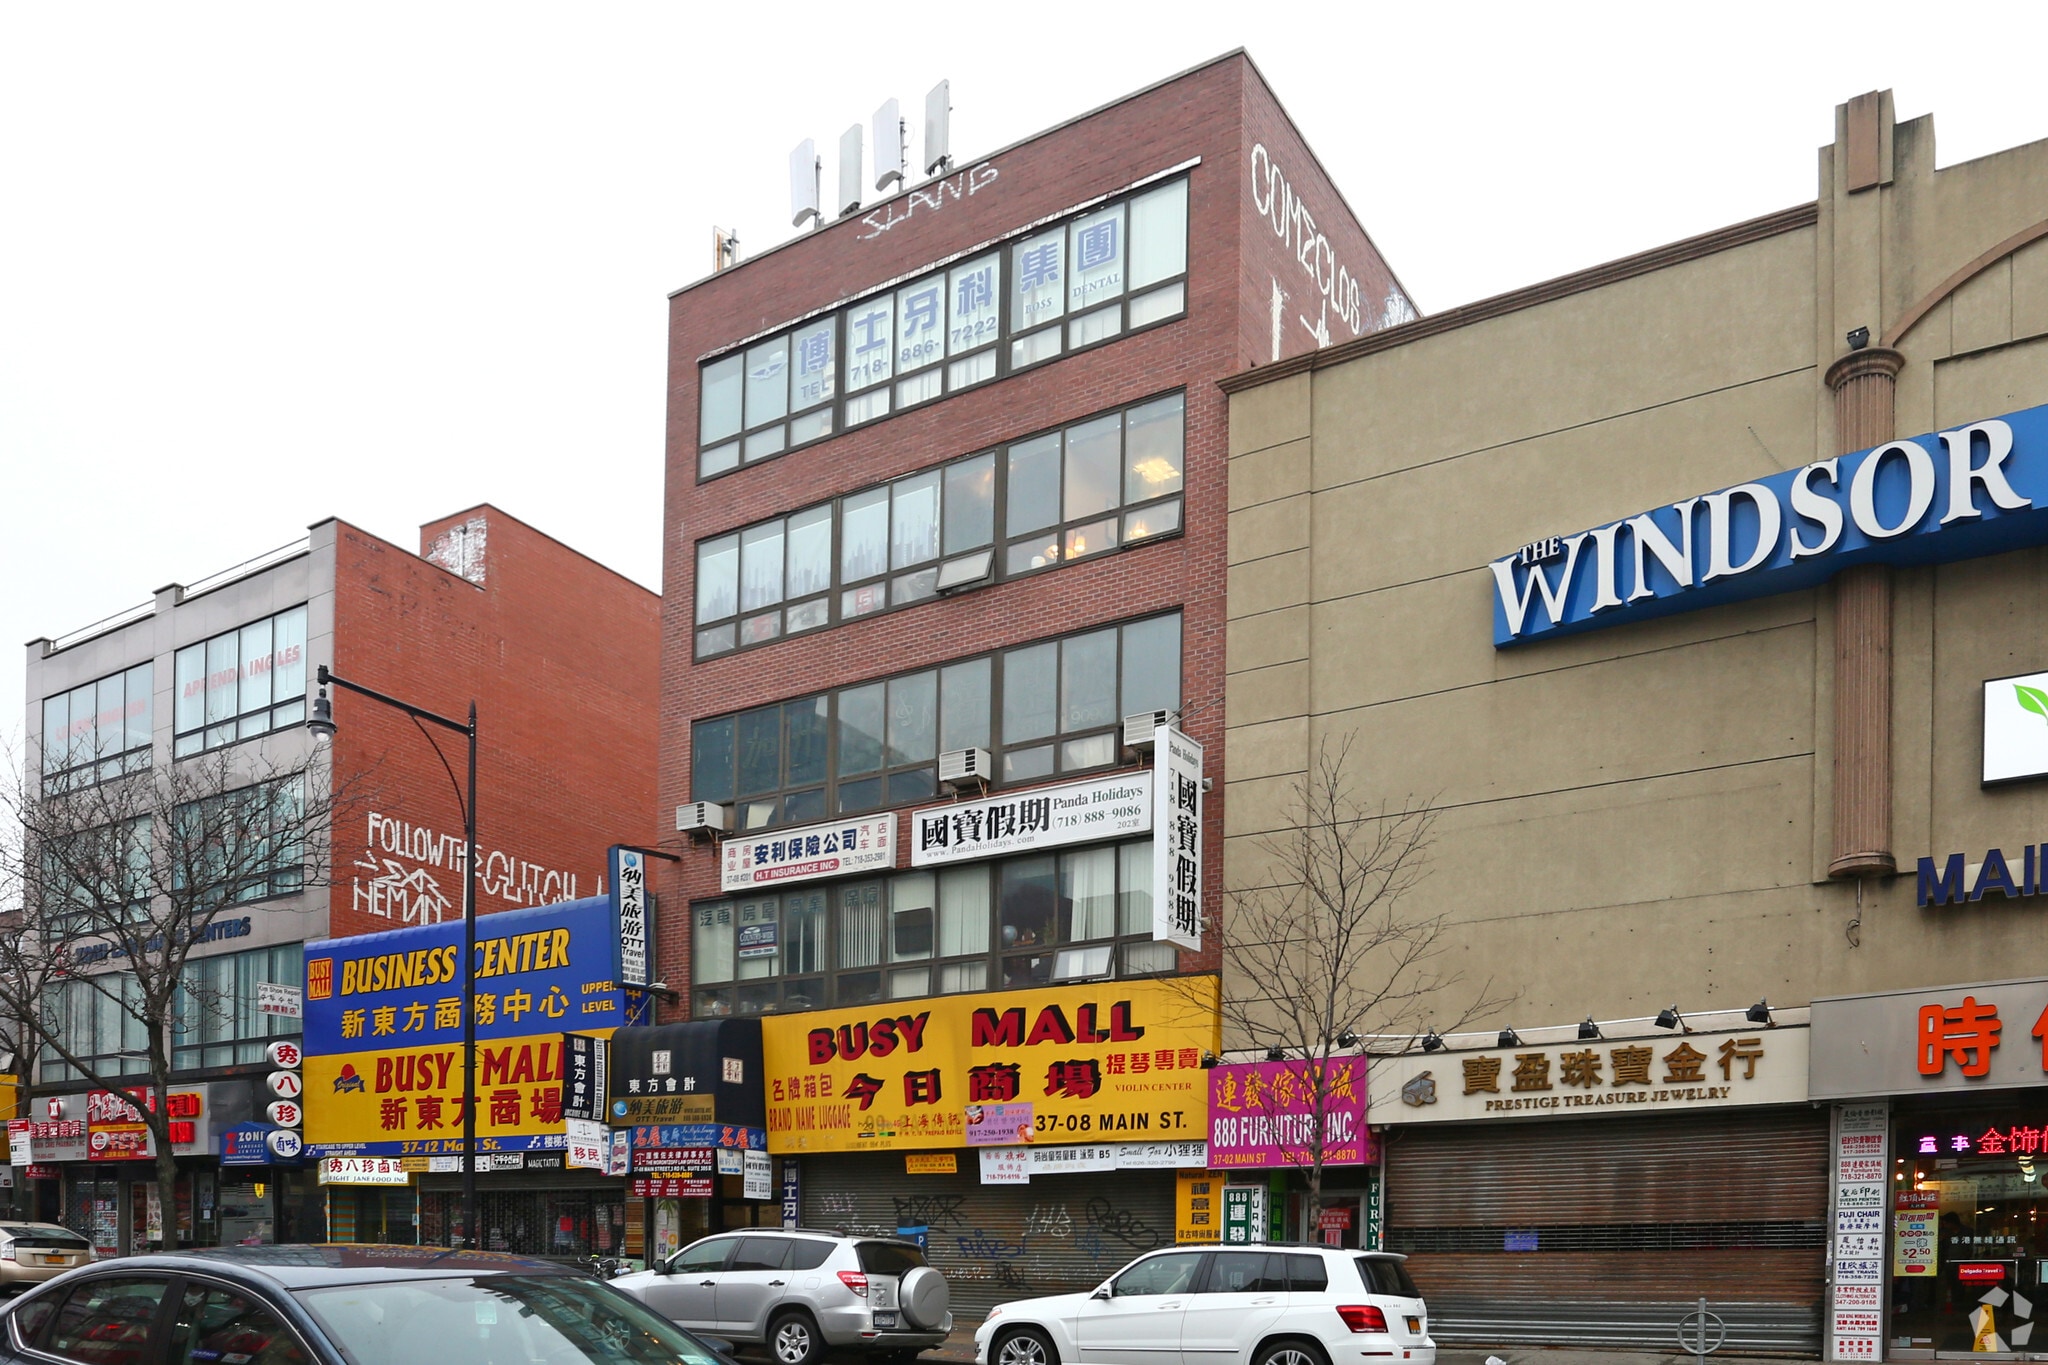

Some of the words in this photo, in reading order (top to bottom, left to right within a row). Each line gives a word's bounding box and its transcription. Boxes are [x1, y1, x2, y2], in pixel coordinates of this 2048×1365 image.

[1072, 272, 1121, 299] DENTAL
[950, 315, 998, 344] 7222
[1488, 418, 2033, 637] WINDSOR
[1518, 536, 1561, 567] THE
[183, 667, 247, 699] APRENDA
[1052, 794, 1088, 810] Panda
[1092, 784, 1144, 804] Holidays
[921, 797, 1052, 852] 國寶假期
[754, 828, 857, 866] 安利保險公司
[1175, 771, 1197, 938] 國寶假期
[770, 863, 818, 879] INSURANCE
[820, 860, 838, 872] INC.
[621, 936, 644, 949] OTT
[622, 946, 645, 959] Travel
[308, 961, 332, 980] BUSY
[340, 944, 458, 996] BUSINESS
[473, 928, 571, 978] CENTER
[308, 979, 332, 998] MALL
[341, 985, 570, 1040] 新東方商務中心
[581, 999, 617, 1014] LEVEL
[808, 1010, 931, 1066] BUSY
[971, 1000, 1146, 1048] MALL
[375, 1051, 456, 1094] BUSY
[1106, 1047, 1199, 1075] 提琴專賣
[1461, 1037, 1765, 1097] 寶盈珠寶金行
[572, 1054, 587, 1108] 東方會計
[628, 1076, 696, 1094] 東方會計
[772, 1071, 833, 1102] 名牌箱包
[841, 1058, 1102, 1112] 今日商場
[1115, 1083, 1150, 1092] VIOLIN
[1151, 1082, 1193, 1091] CENTER
[1485, 1096, 1560, 1111] PRESTIGE
[1564, 1091, 1649, 1108] TREASURE
[1651, 1086, 1731, 1103] JEWELRY
[769, 1107, 792, 1132] BRAND
[795, 1105, 815, 1131] NAME
[819, 1104, 851, 1130] LUGGAGE
[1035, 1113, 1092, 1131] 37-08
[1099, 1112, 1157, 1131] MAIN
[1160, 1111, 1188, 1128] ST.
[1213, 1116, 1238, 1148] 888
[1240, 1113, 1323, 1147] FURNITUR
[1326, 1111, 1357, 1143] INC.
[238, 1131, 264, 1142] ZONI
[968, 1128, 1015, 1137] 917-250-1938
[401, 1140, 439, 1154] 37-12
[482, 1138, 502, 1151] St.
[573, 1146, 601, 1162] 移民
[1098, 1150, 1111, 1160] B5
[1119, 1145, 1143, 1157] Small
[1147, 1146, 1162, 1158] Fox
[1213, 1154, 1234, 1165] 37-02
[1235, 1153, 1254, 1164] MAIN
[1255, 1152, 1266, 1163] ST
[1179, 1171, 1205, 1179] Natural
[1840, 1172, 1883, 1180] 718-321-8870
[1229, 1192, 1248, 1202] 888
[1230, 1204, 1246, 1242] 連發
[1838, 1211, 1855, 1219] FUJI
[1856, 1210, 1880, 1218] CHAIR
[1902, 1247, 1931, 1260] $2.50
